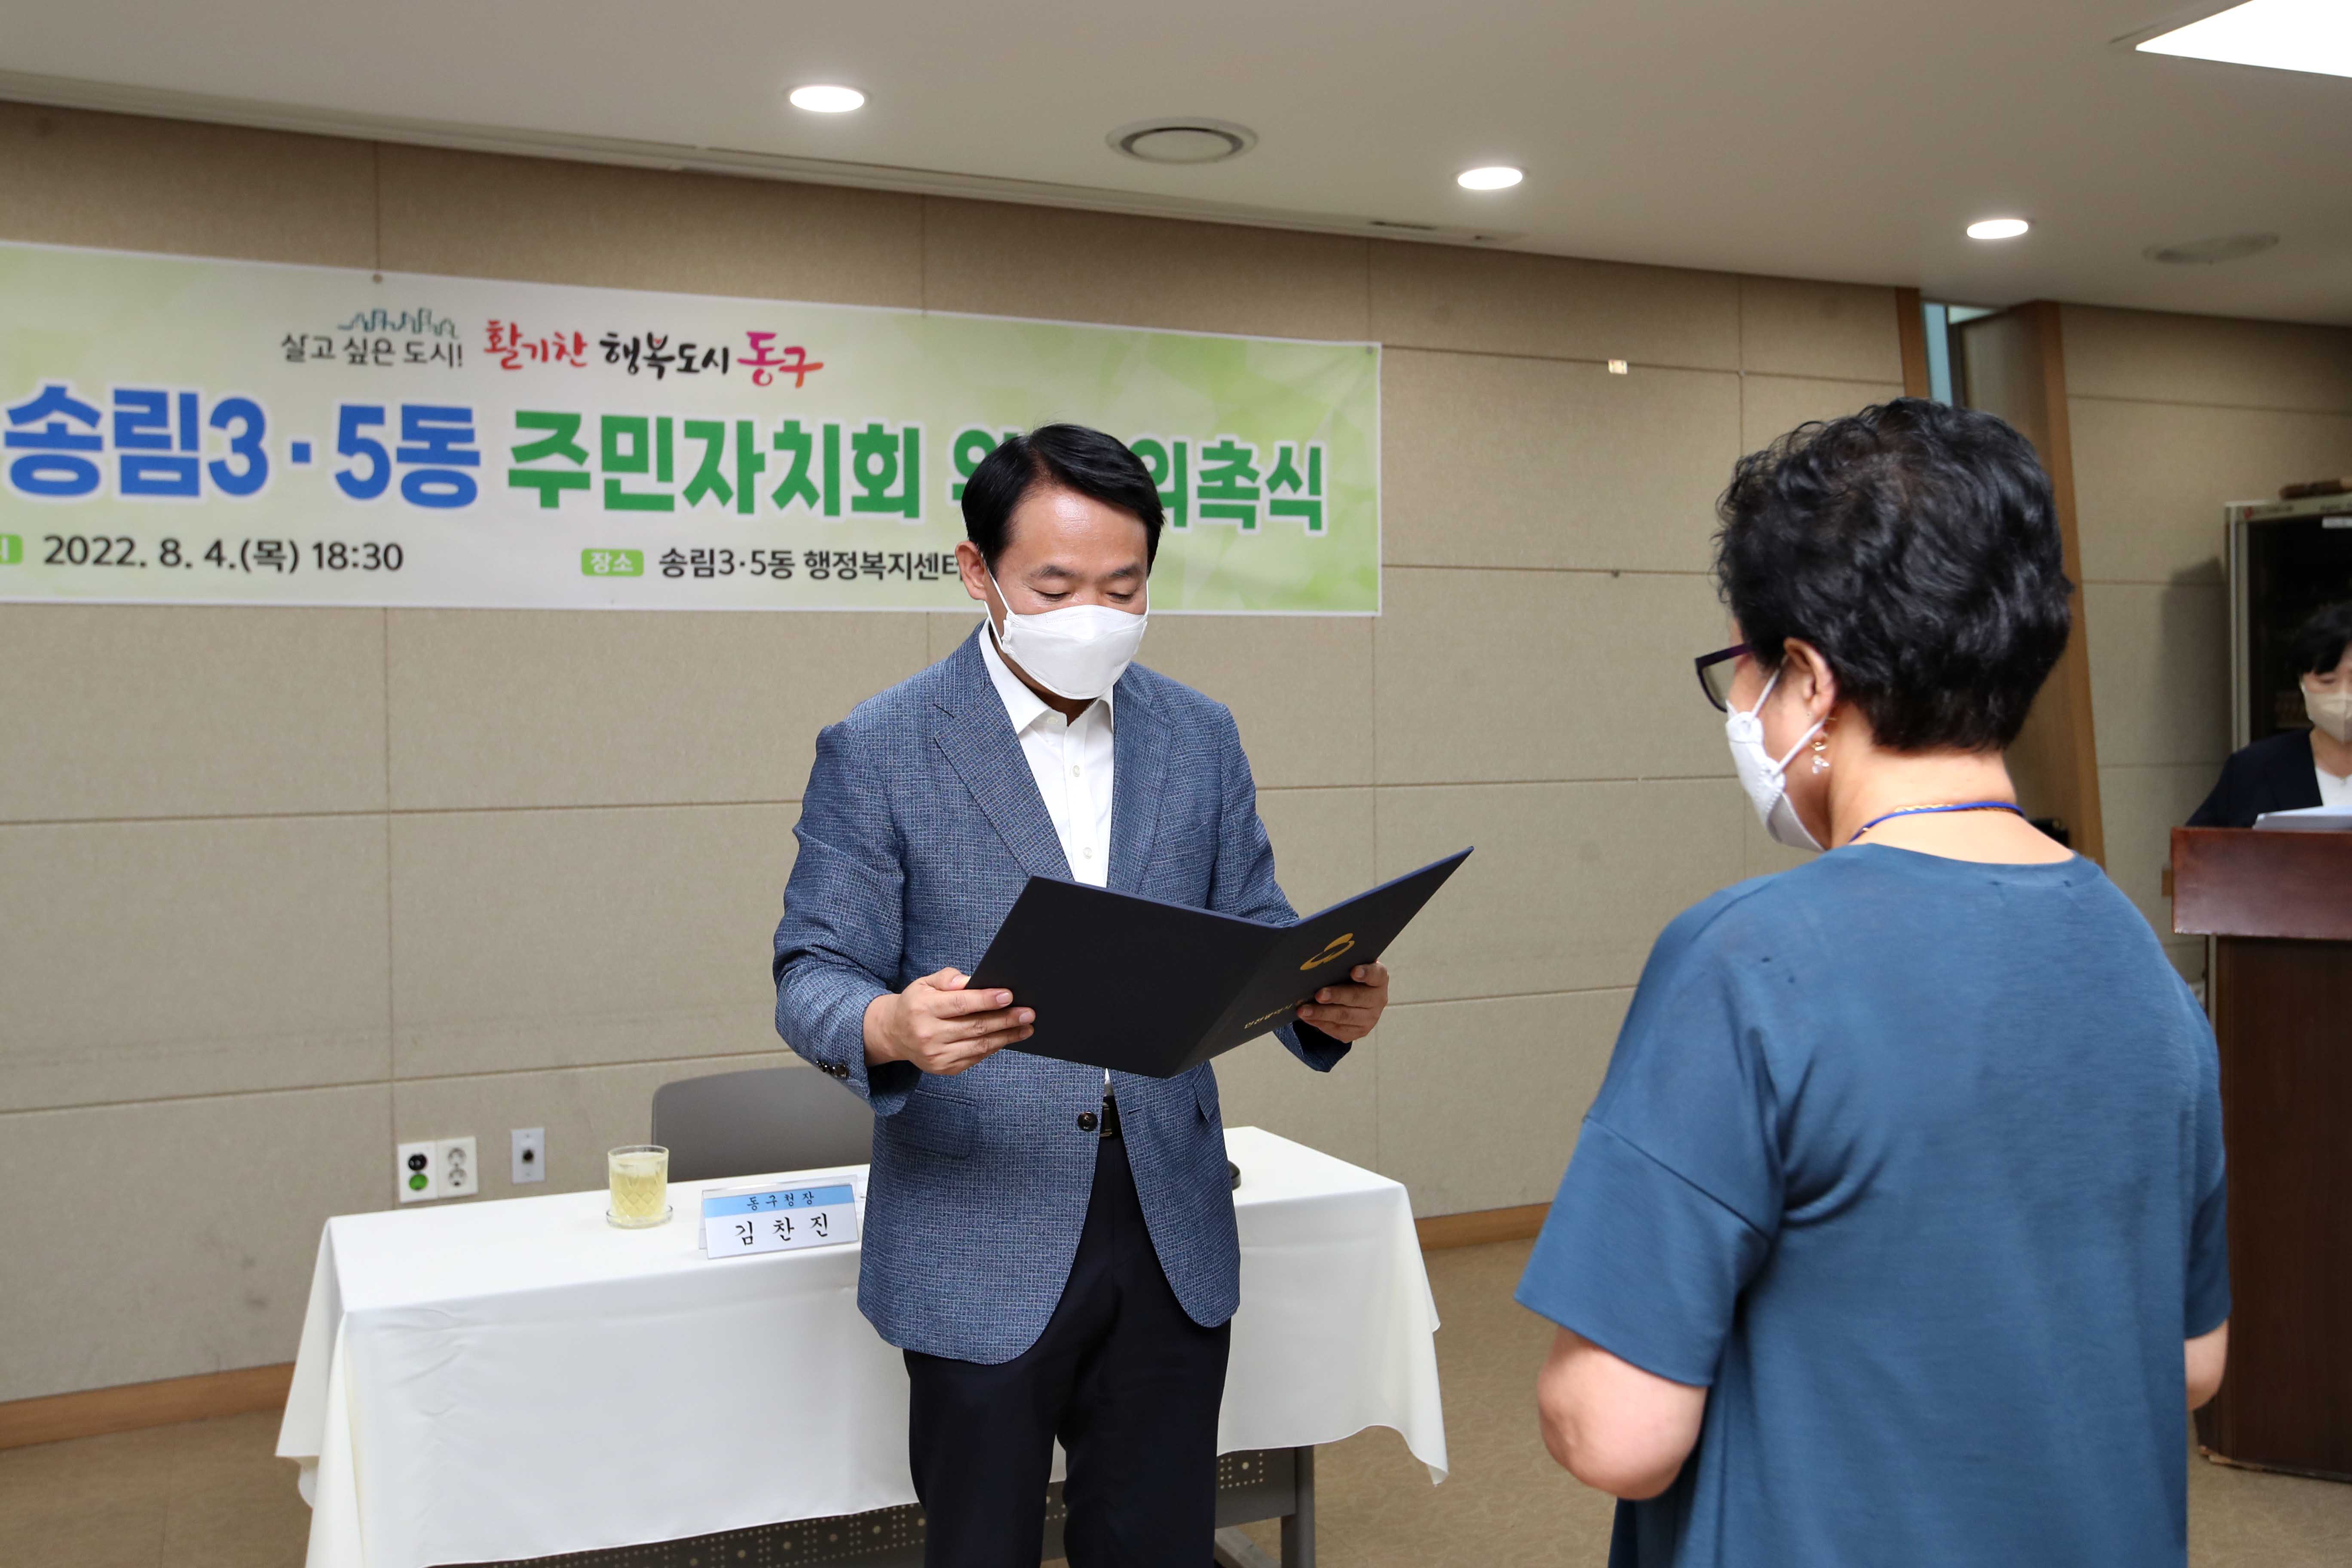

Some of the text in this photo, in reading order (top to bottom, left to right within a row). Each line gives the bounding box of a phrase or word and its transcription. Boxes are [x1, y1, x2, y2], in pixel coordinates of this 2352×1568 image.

[281, 320, 824, 389] 살고 싶은 도시! 활기찬 행복도시 동구
[508, 410, 919, 518] 주민자치회
[1130, 438, 1322, 531] 위촉식
[44, 536, 147, 568] 2022.
[159, 539, 192, 569] 8.
[312, 542, 404, 571] 18:30
[590, 551, 634, 573] 장소
[659, 548, 795, 579] 송림3·5동
